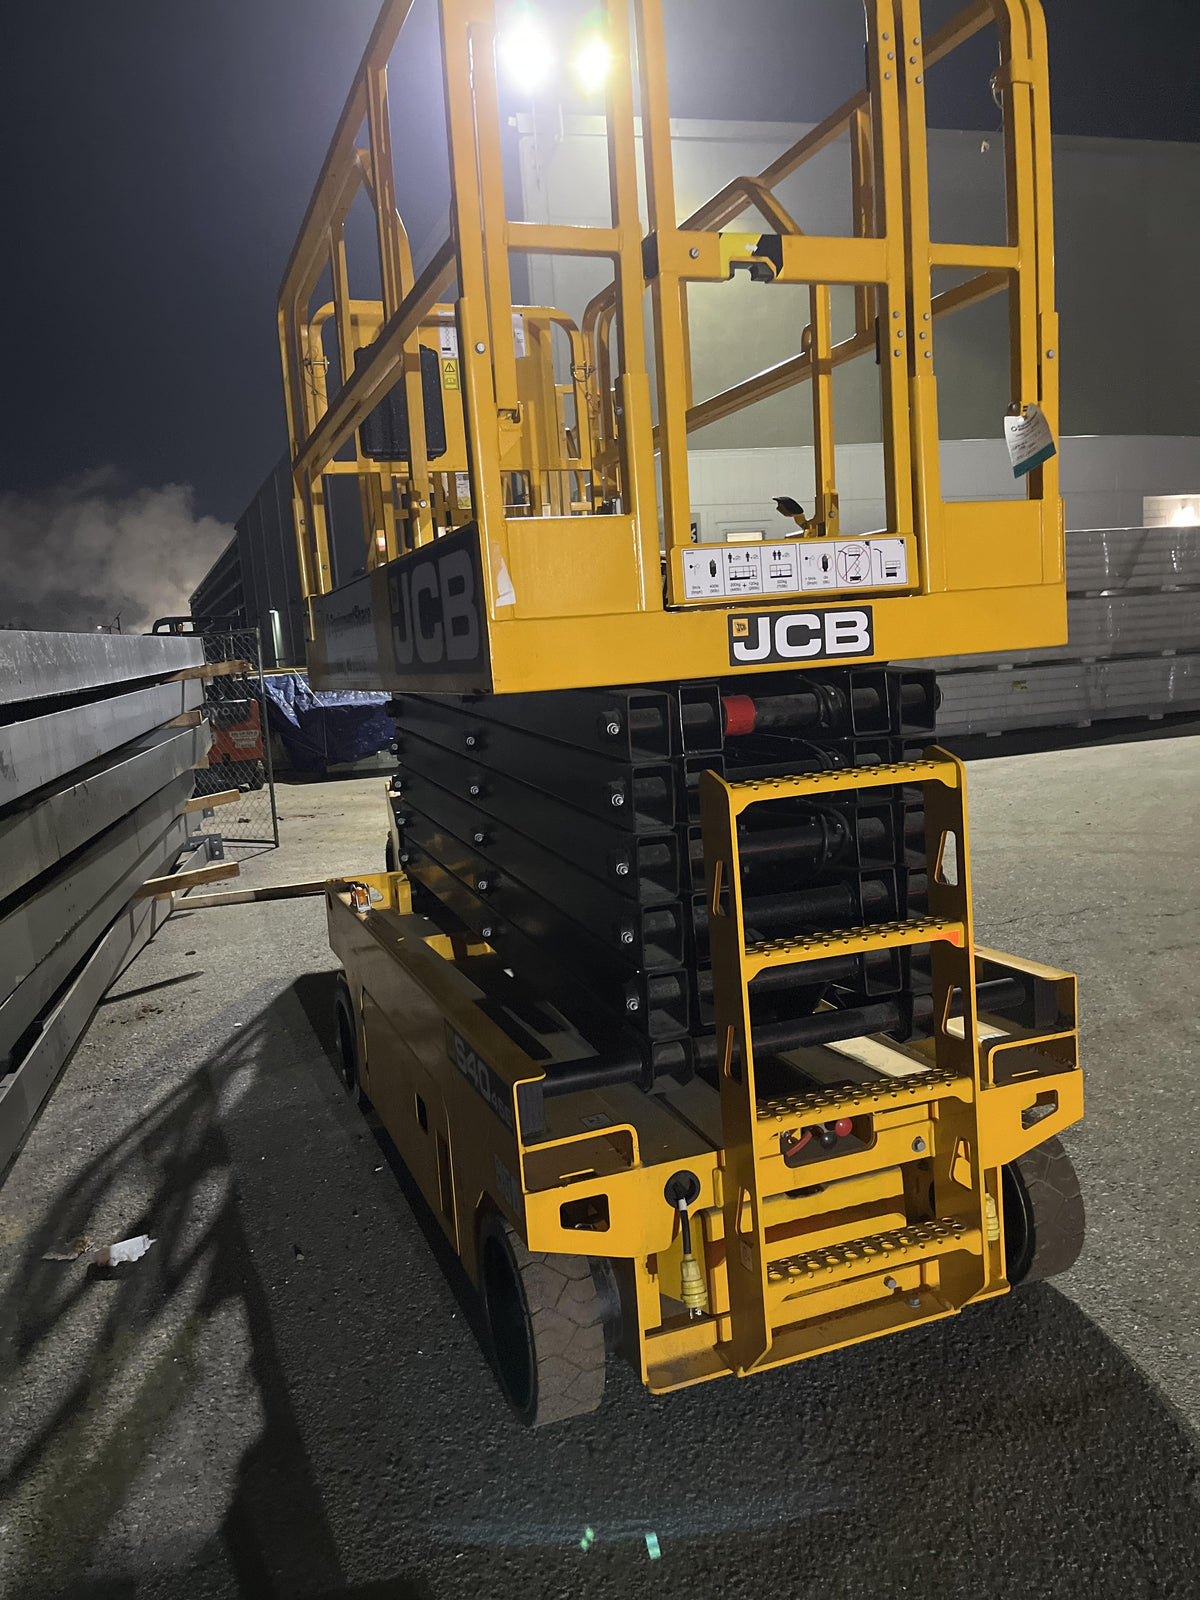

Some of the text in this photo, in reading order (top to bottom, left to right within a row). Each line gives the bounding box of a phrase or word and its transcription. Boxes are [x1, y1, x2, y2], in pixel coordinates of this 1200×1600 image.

[393, 550, 480, 665] JCB
[733, 611, 871, 661] JCB
[202, 706, 248, 717] OYOTA
